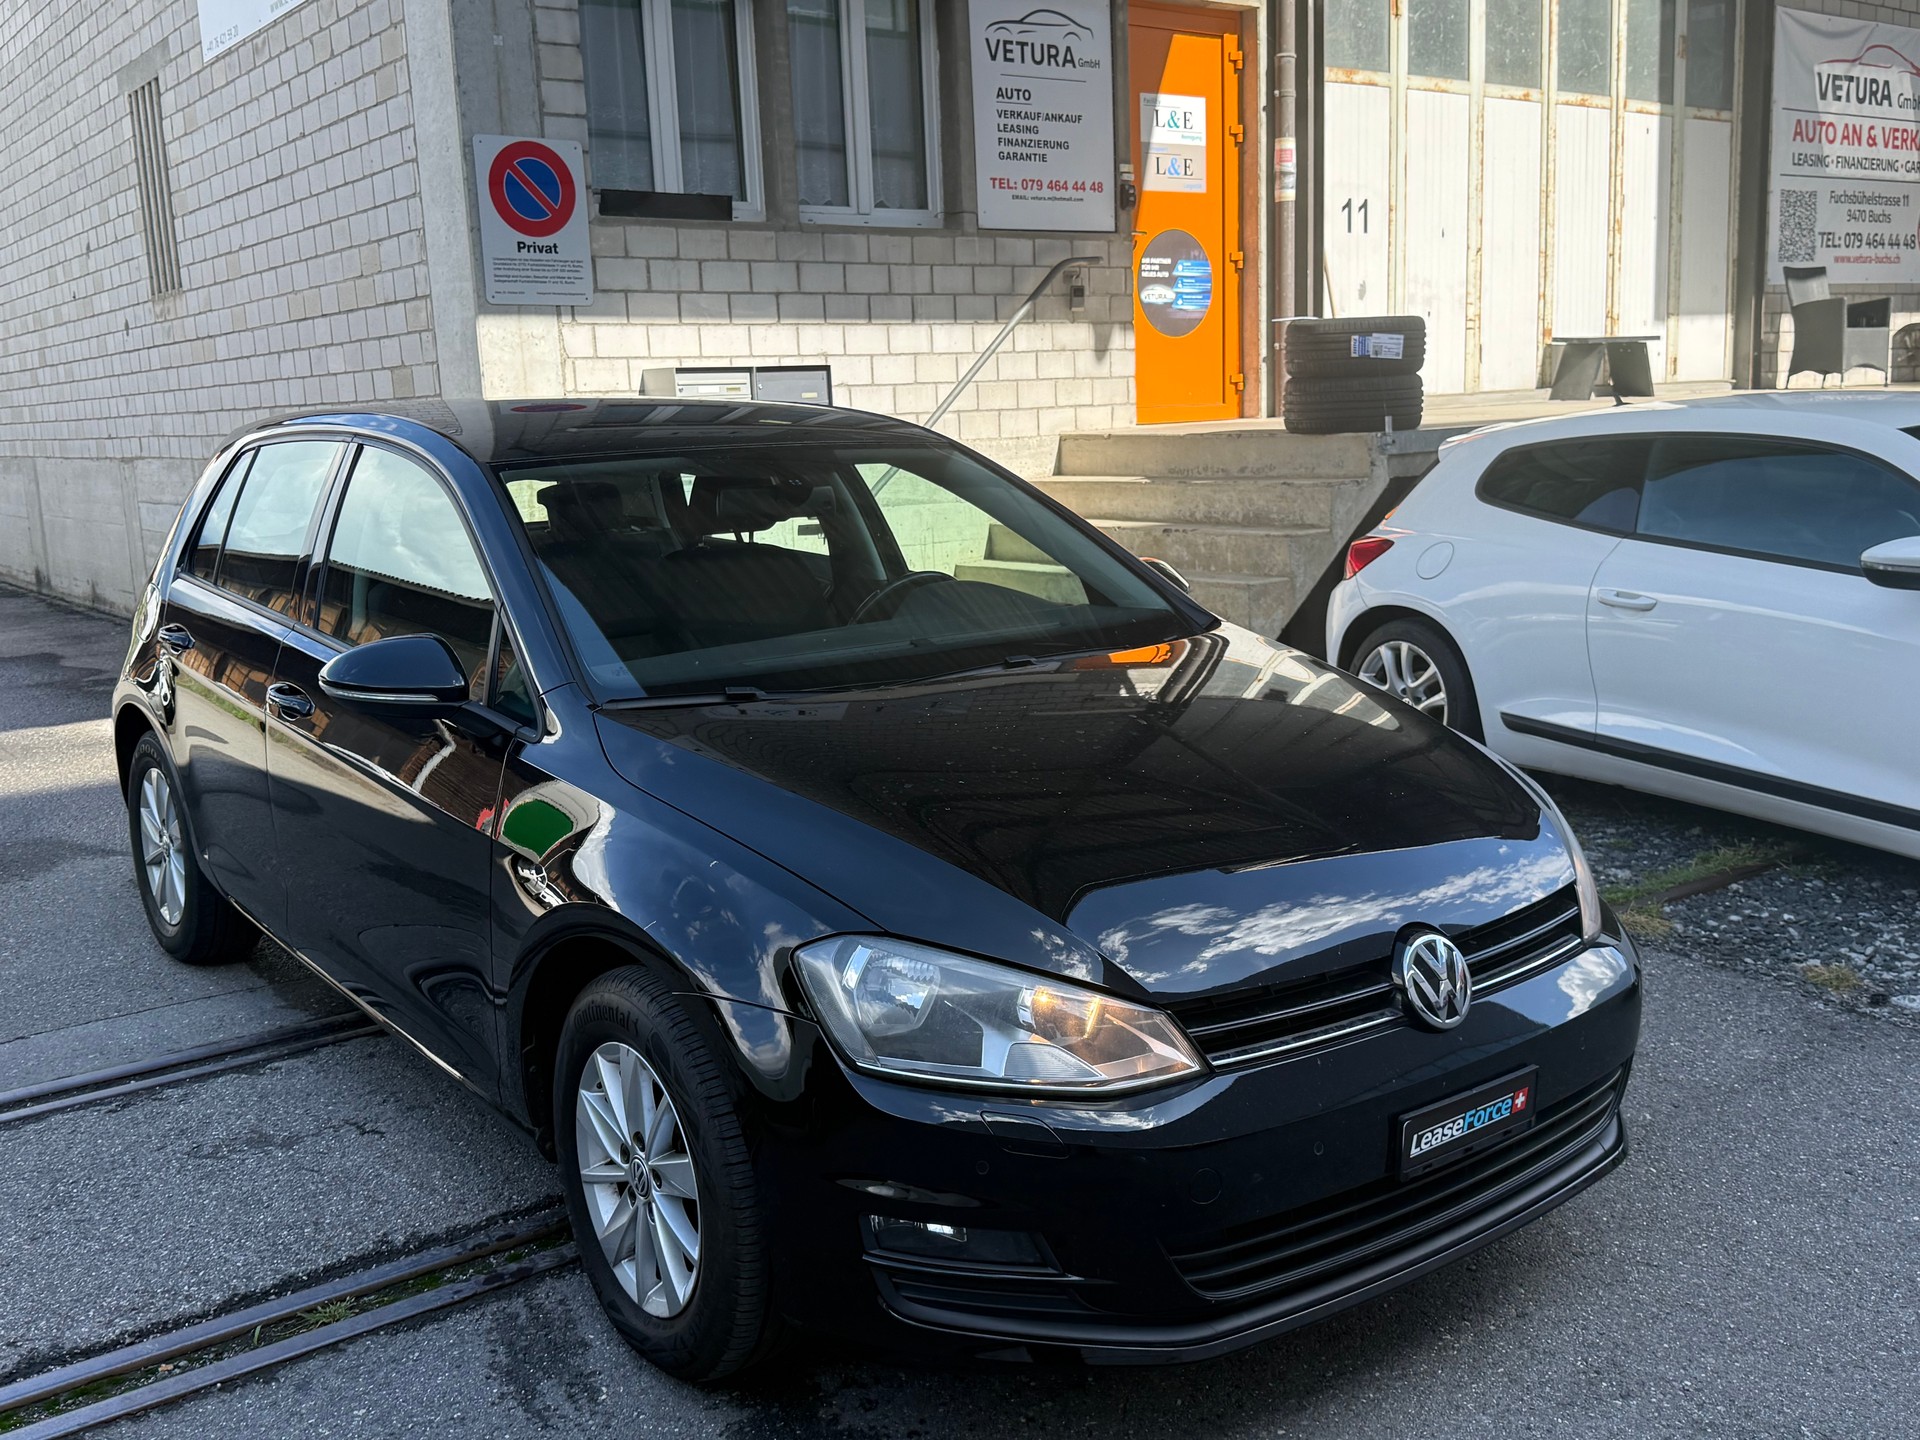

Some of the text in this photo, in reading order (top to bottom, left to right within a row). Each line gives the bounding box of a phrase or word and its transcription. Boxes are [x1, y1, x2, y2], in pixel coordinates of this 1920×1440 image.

[985, 37, 1101, 69] VETURA GmbH
[996, 87, 1032, 101] AUTO
[1817, 72, 1893, 107] VETURA
[996, 109, 1083, 124] VERKAUF/ANKAUF
[997, 123, 1040, 135] LEASING
[1792, 119, 1838, 144] AUTO
[1840, 123, 1863, 147] AN
[1866, 125, 1878, 148] &
[998, 137, 1070, 150] FINANZIERUNG
[998, 151, 1048, 163] GARANTIE
[1792, 152, 1830, 168] LEASING
[1836, 156, 1899, 172] FINANZIERUNG
[990, 177, 1104, 193] TEL: 079 464 44 48
[1829, 190, 1910, 207] Fuchsbühelstrasse 11
[1342, 198, 1368, 234] 11
[1846, 209, 1892, 223] 9470 Buchs
[516, 241, 559, 255] Privat
[1818, 232, 1917, 249] TEL: 079 464 44 48
[1410, 1097, 1513, 1156] LeaseForce
